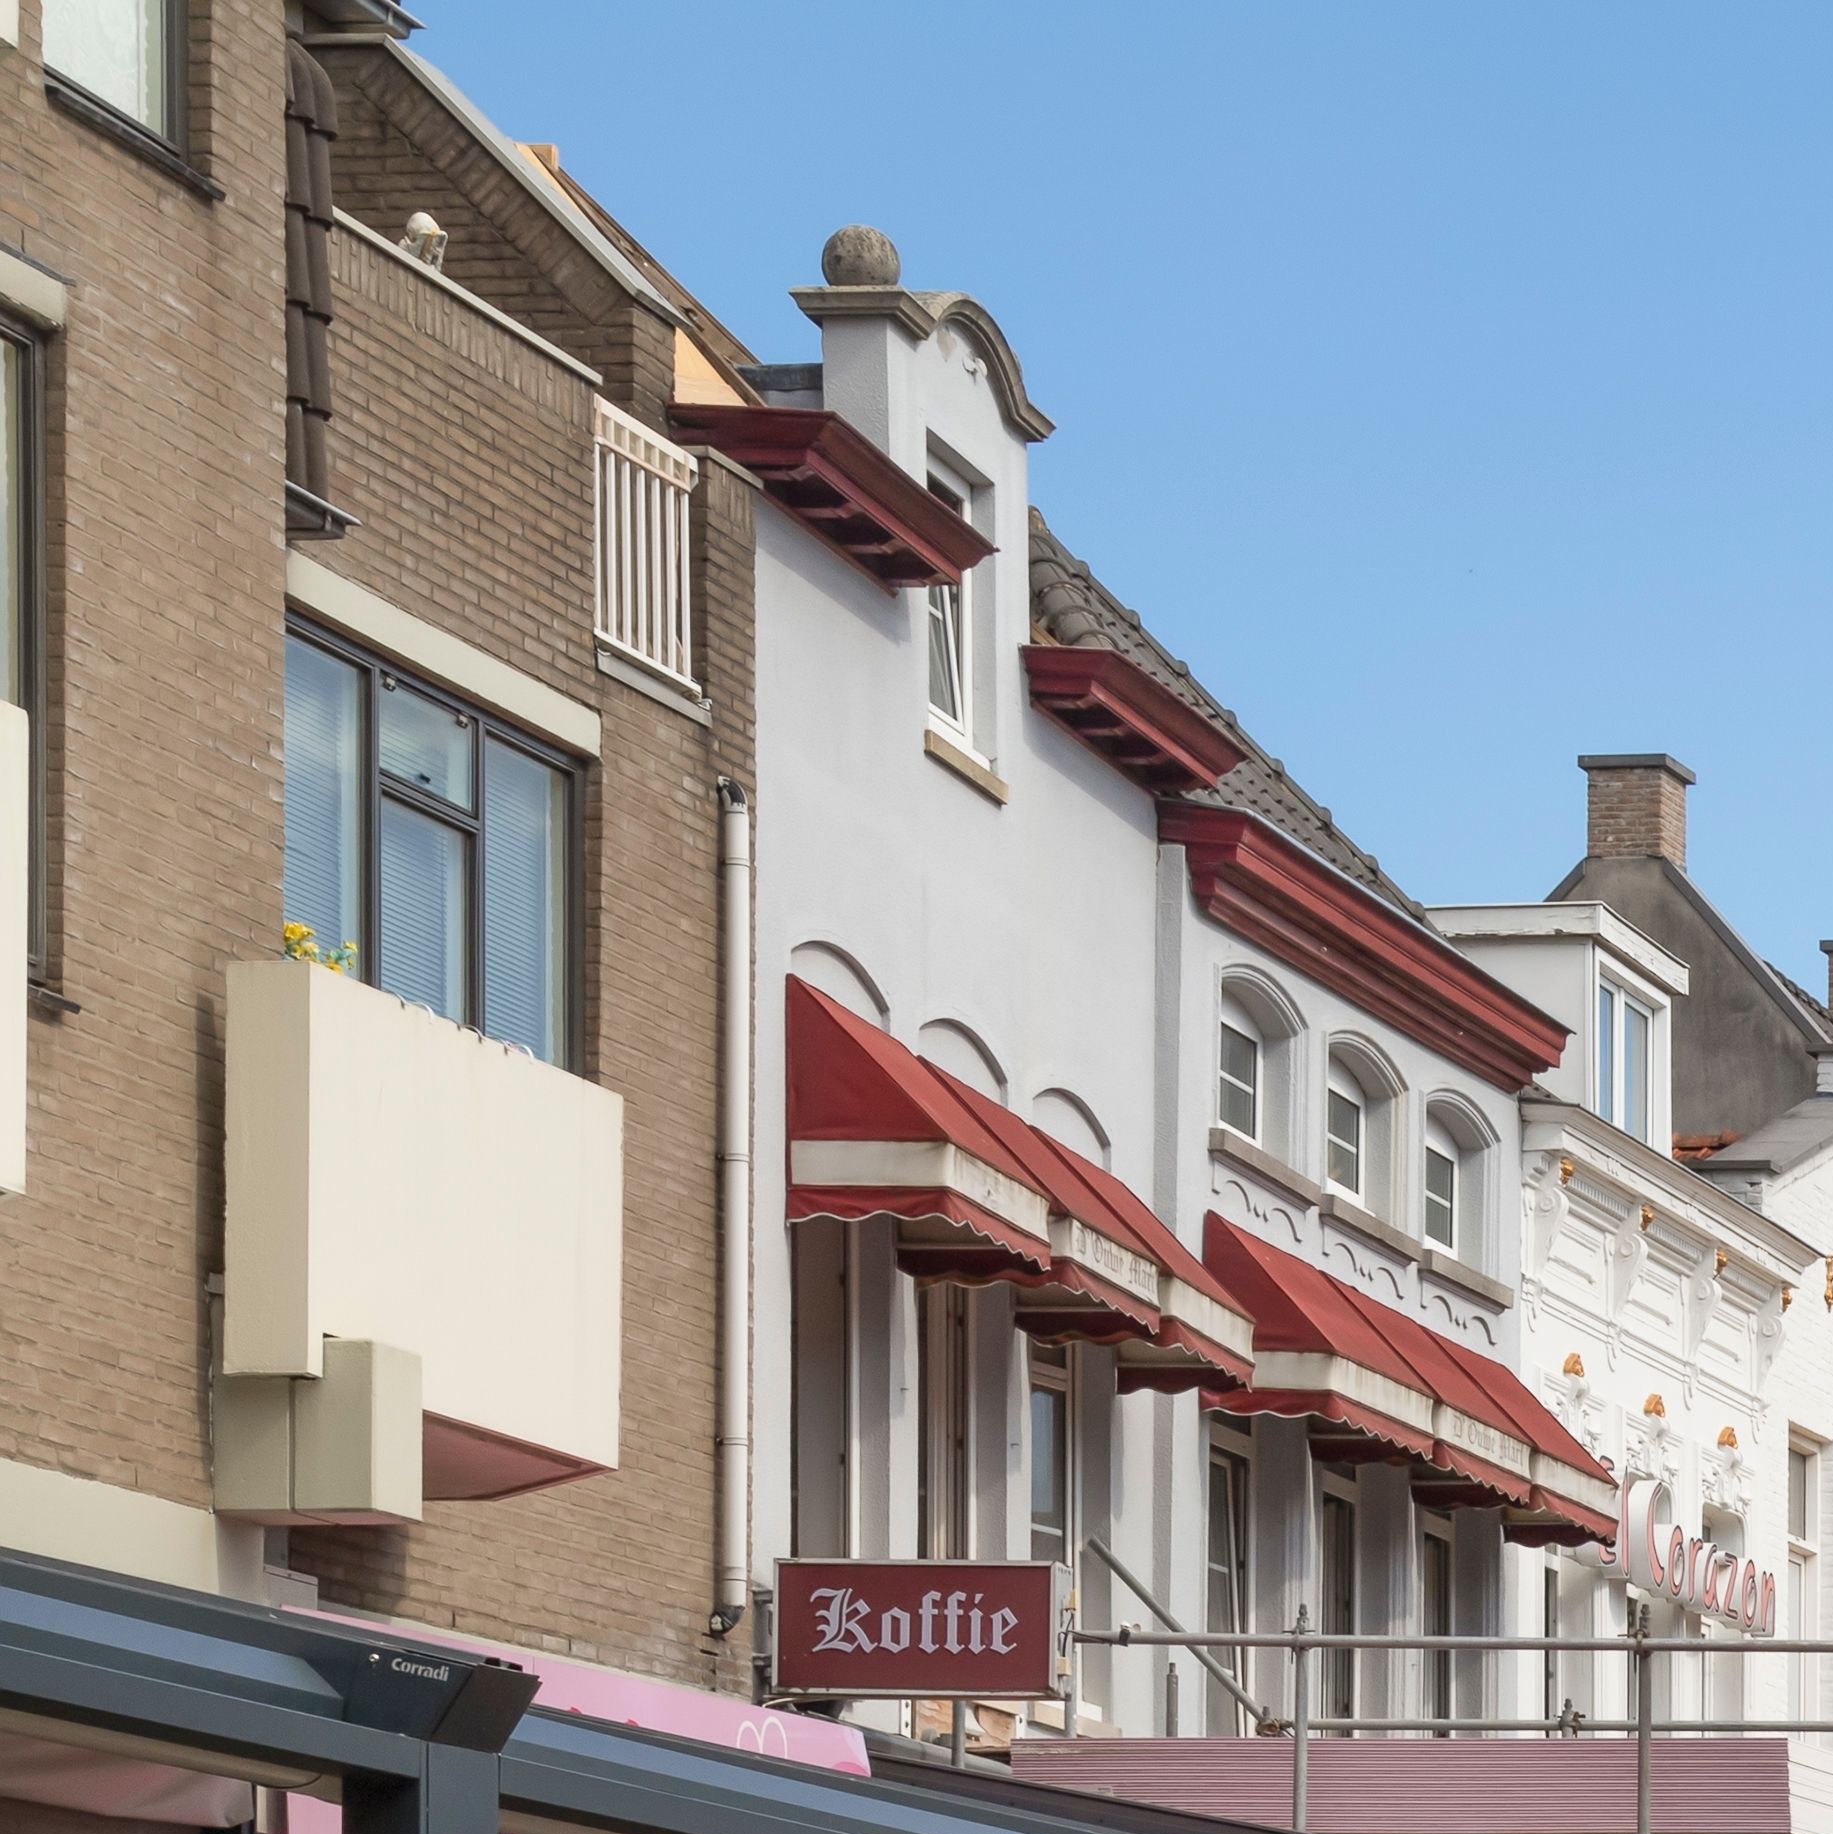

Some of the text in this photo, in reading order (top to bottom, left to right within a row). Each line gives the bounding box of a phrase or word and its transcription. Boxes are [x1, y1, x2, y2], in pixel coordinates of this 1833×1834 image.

[1646, 1481, 1776, 1634] Corazon
[810, 1587, 1019, 1655] Koffie
[391, 1657, 450, 1682] Corradi
